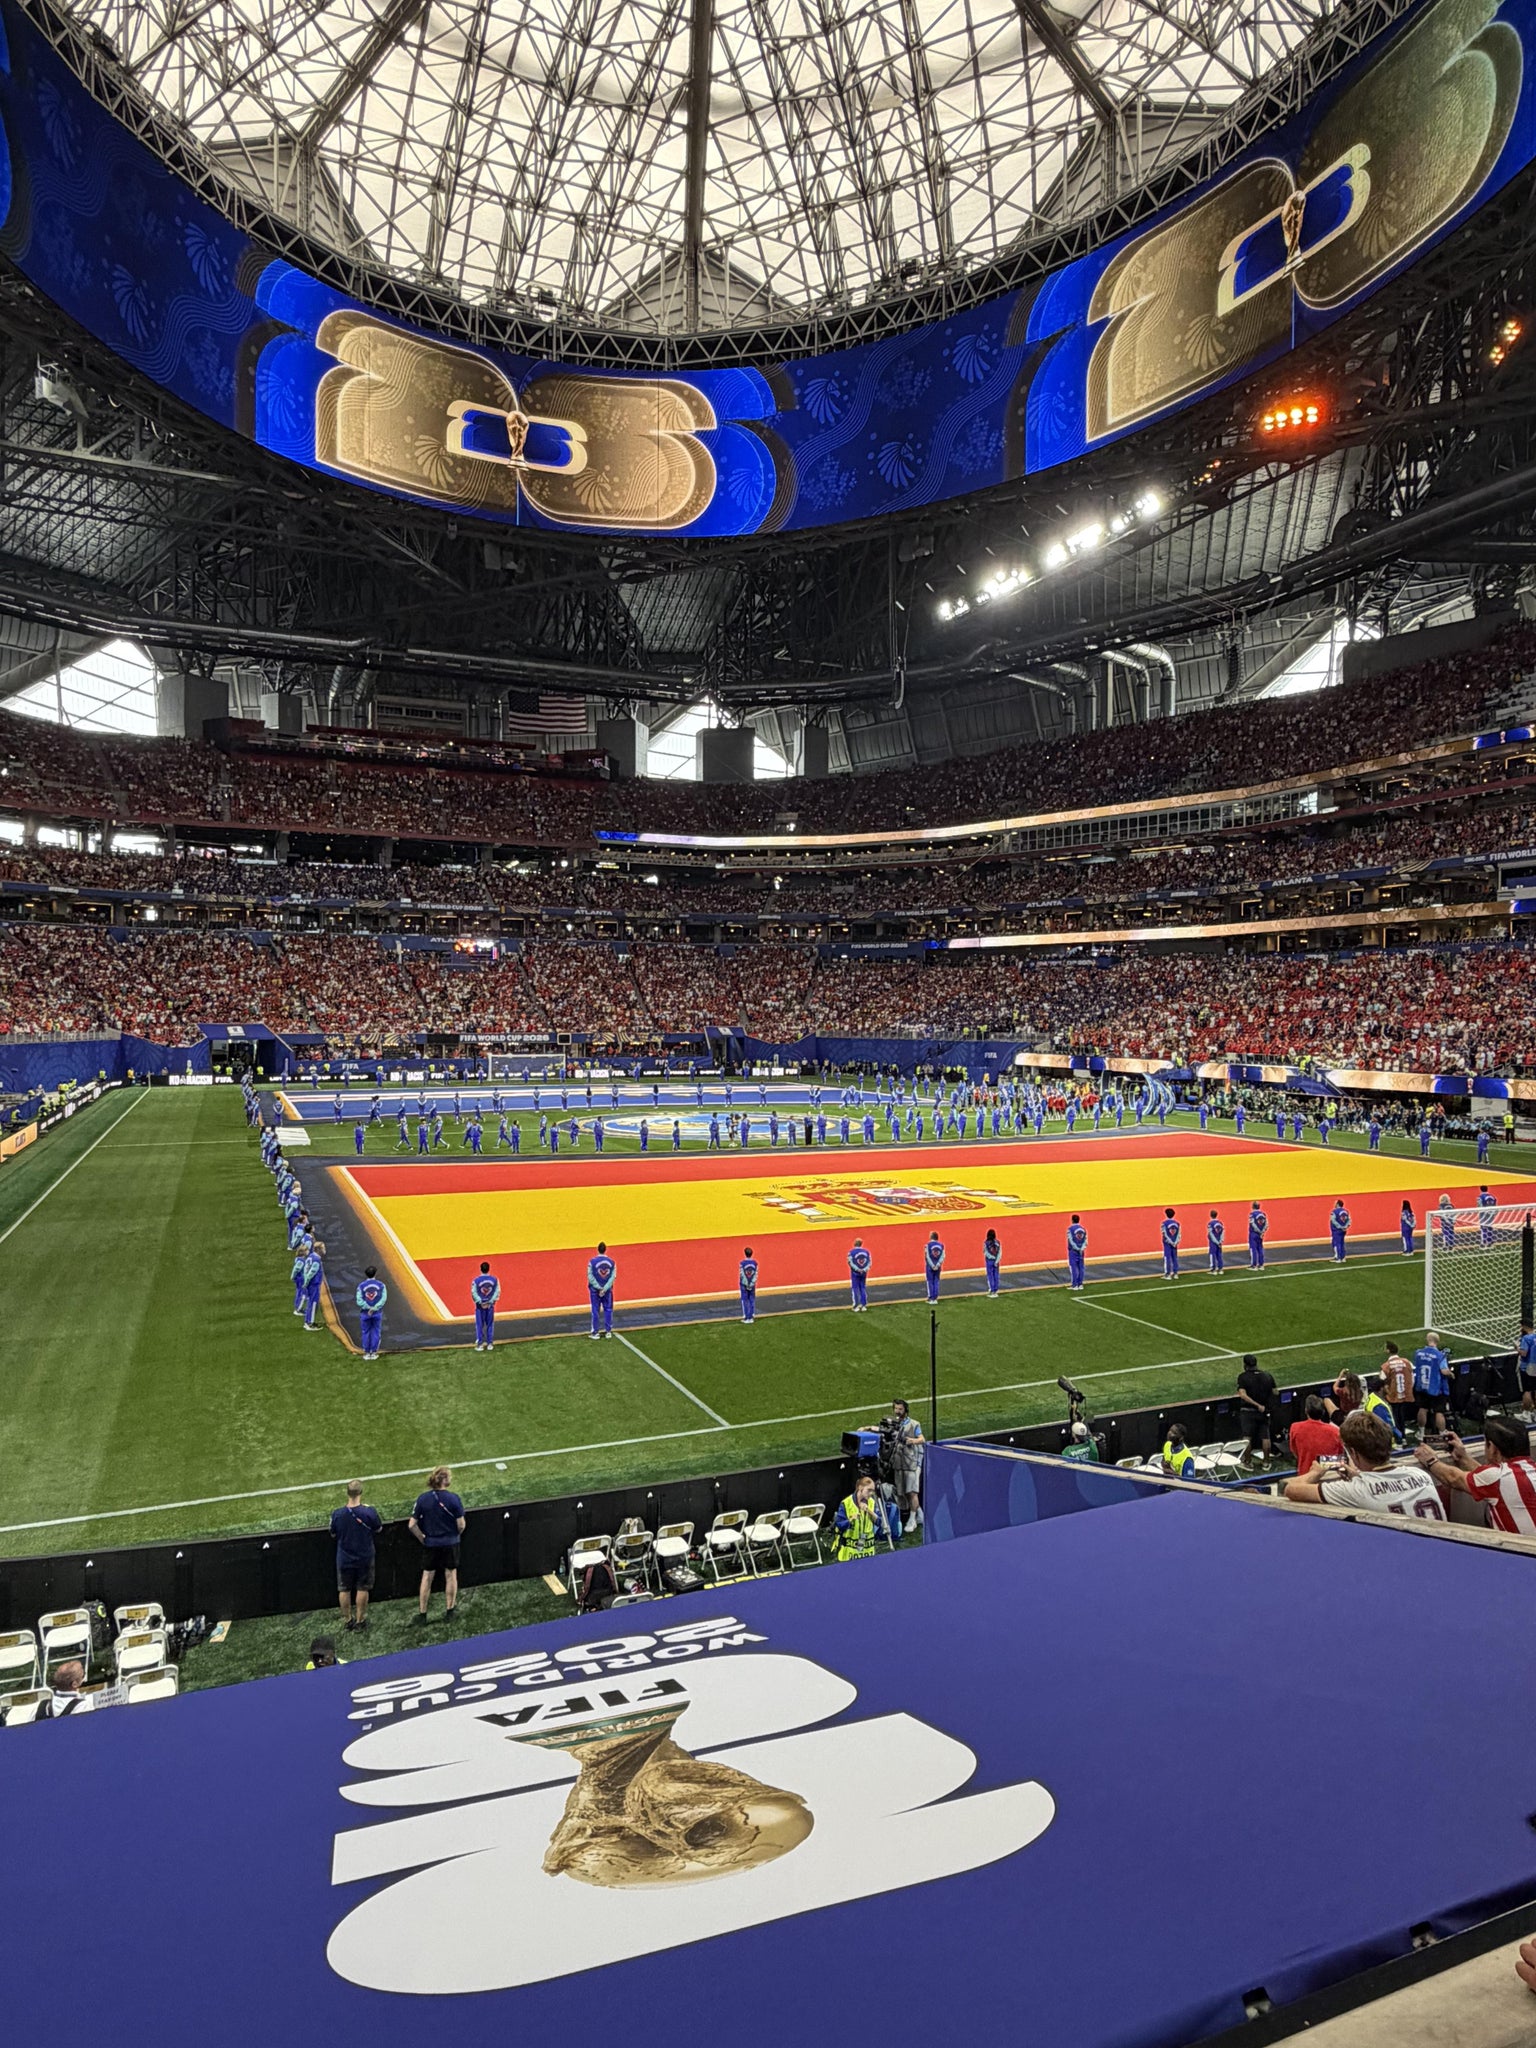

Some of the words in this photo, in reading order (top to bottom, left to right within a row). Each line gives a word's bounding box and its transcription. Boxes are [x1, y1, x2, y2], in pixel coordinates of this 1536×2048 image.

[1490, 853, 1507, 861] FIFA
[1272, 876, 1313, 887] ATLANTA
[1026, 900, 1063, 908] ATLANTA
[460, 1034, 477, 1042] FIFA
[478, 1034, 505, 1042] WORLD
[507, 1034, 522, 1042] CUP
[523, 1034, 549, 1042] 2026
[1369, 1480, 1408, 1496] LAMINE
[846, 1538, 875, 1548] SECITY
[350, 1616, 747, 1704] 2026
[513, 1632, 770, 1686] WORLD
[347, 1683, 498, 1720] CUP
[474, 1678, 688, 1728] FIFA
